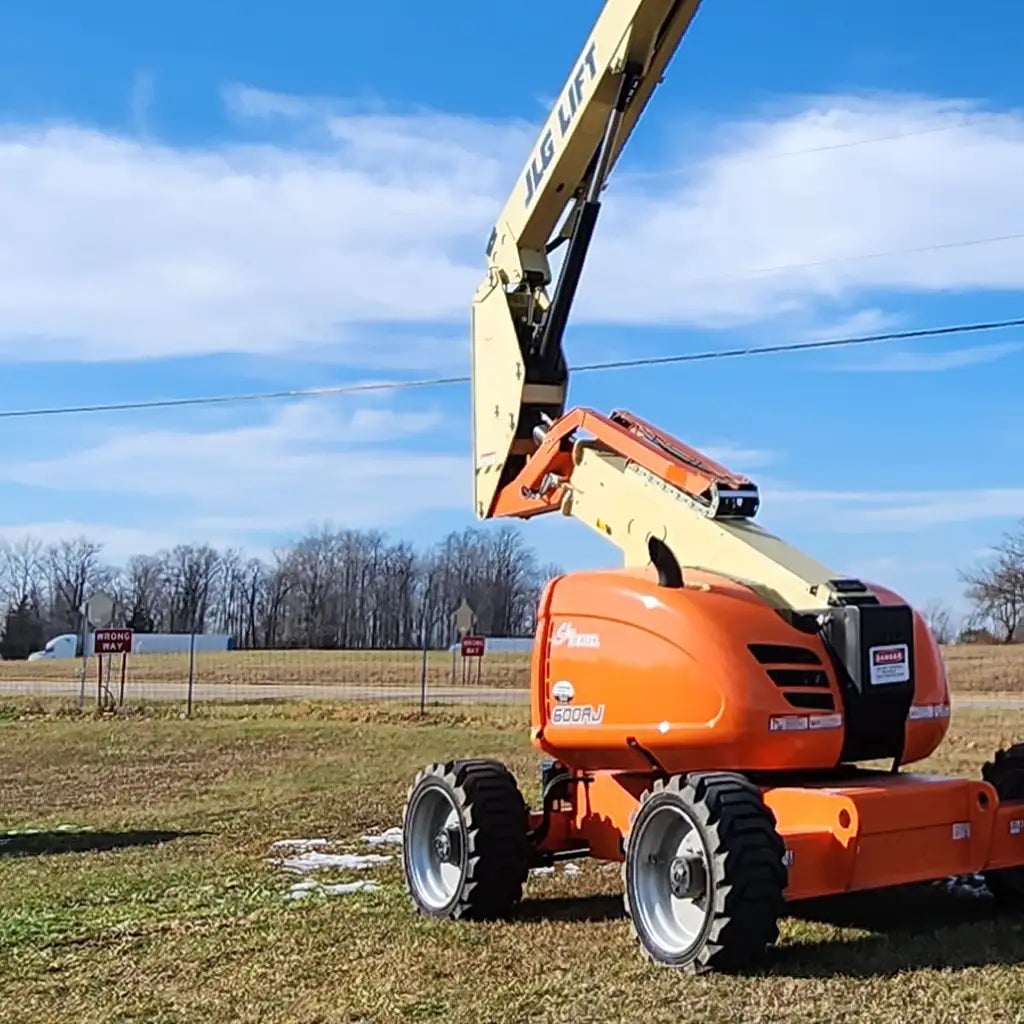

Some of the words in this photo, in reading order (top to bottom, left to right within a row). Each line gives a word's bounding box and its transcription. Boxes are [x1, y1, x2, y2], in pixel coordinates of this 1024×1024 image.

[525, 128, 556, 208] JLG
[557, 42, 597, 138] LIFT
[96, 631, 131, 641] WRONG
[102, 642, 123, 651] WAY
[552, 705, 604, 724] 600AJ
